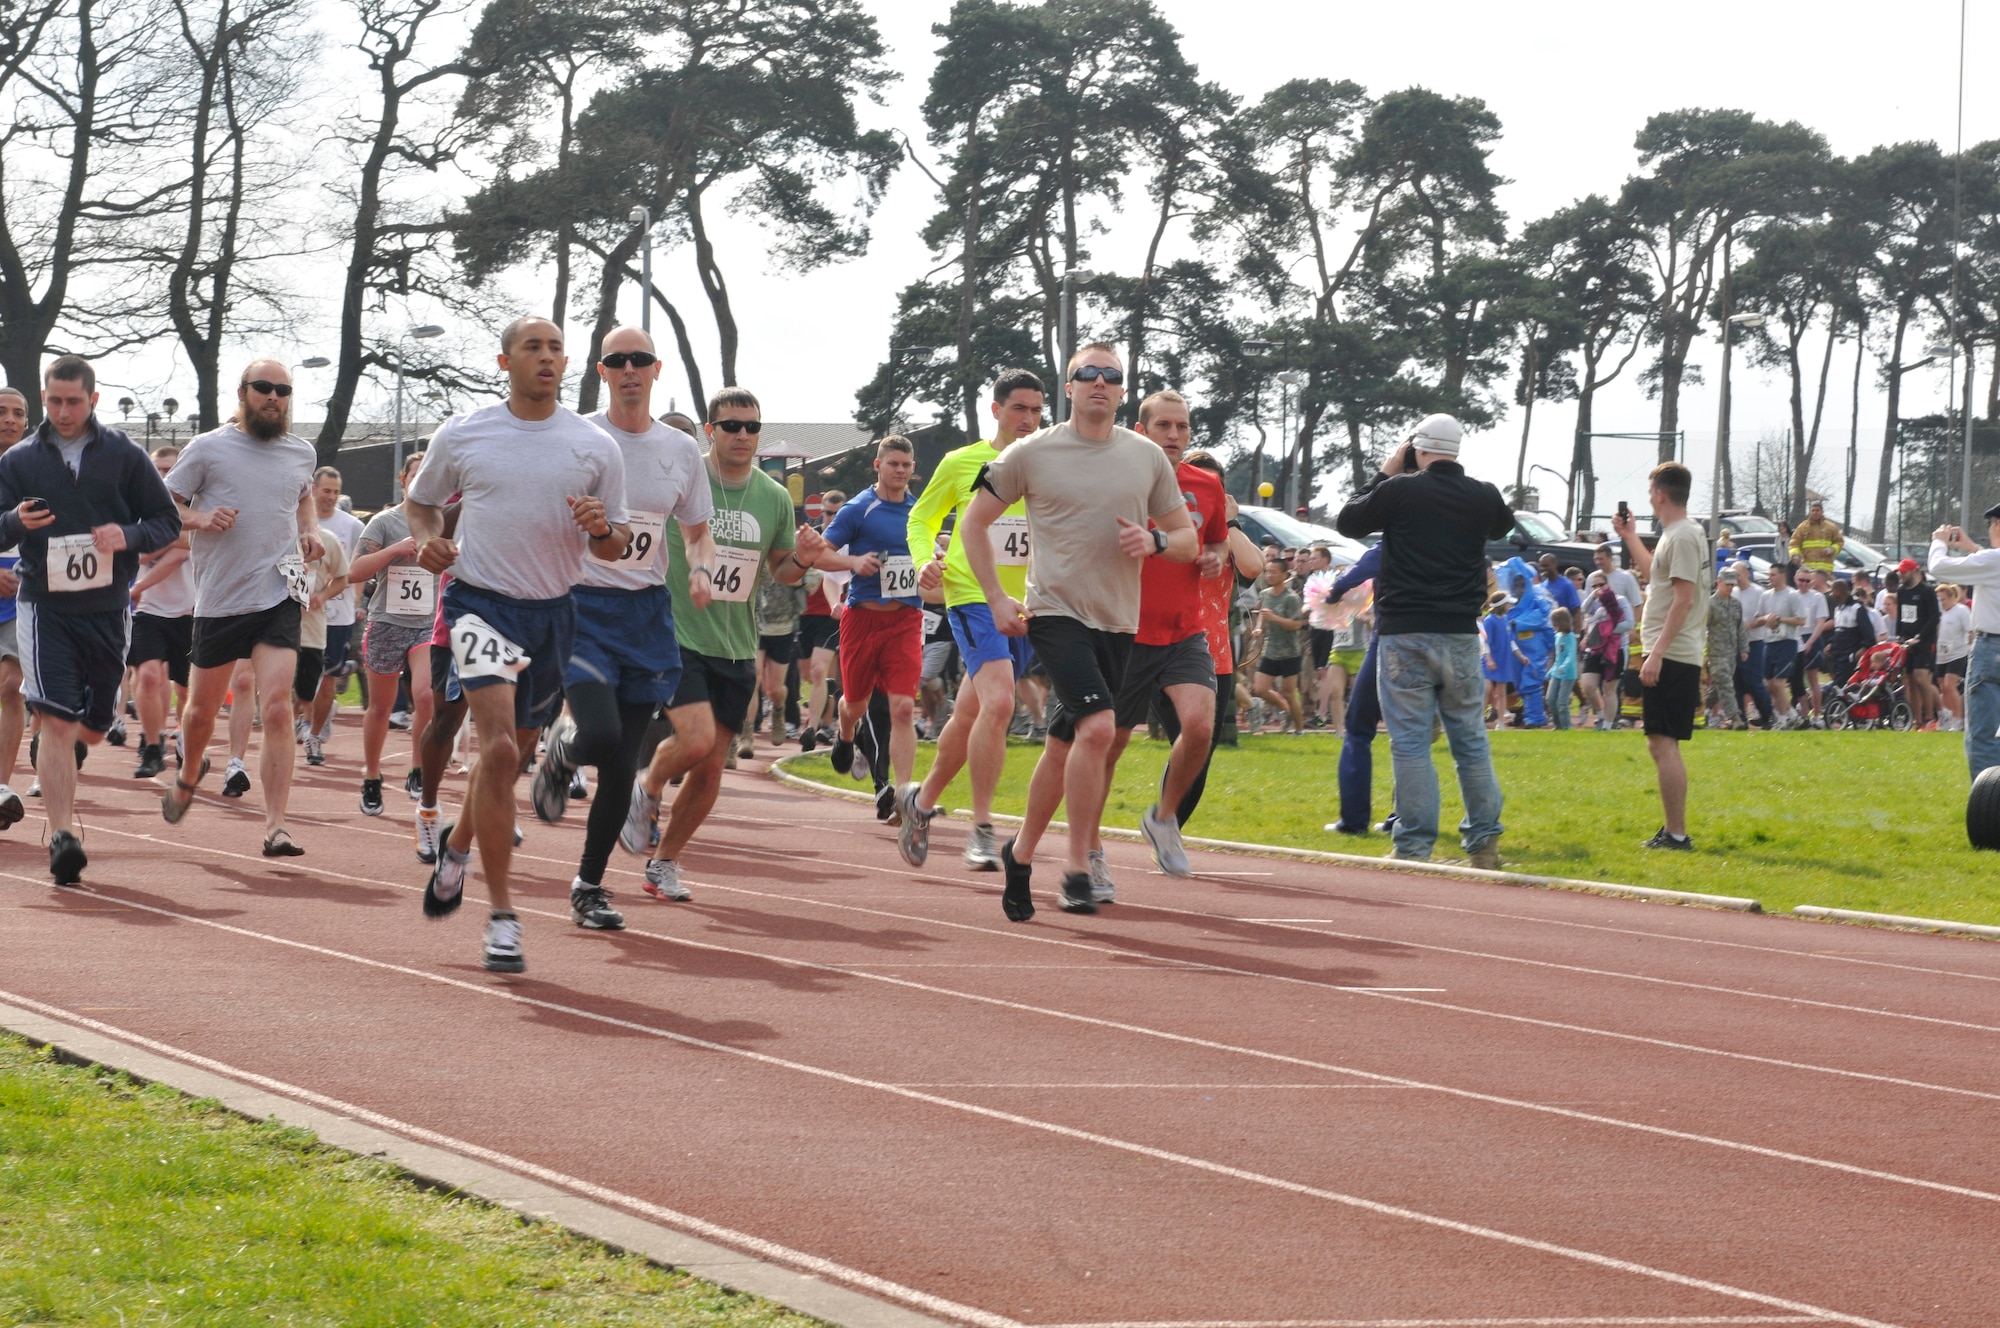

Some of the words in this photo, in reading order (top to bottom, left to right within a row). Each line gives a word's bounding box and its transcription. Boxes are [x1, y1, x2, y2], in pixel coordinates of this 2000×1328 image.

[707, 517, 741, 531] ORTH
[717, 508, 741, 521] THE
[710, 527, 741, 541] FACE
[1004, 532, 1029, 557] 45
[66, 553, 98, 581] 60
[713, 564, 741, 593] 46
[886, 568, 915, 591] 268
[400, 579, 422, 601] 56
